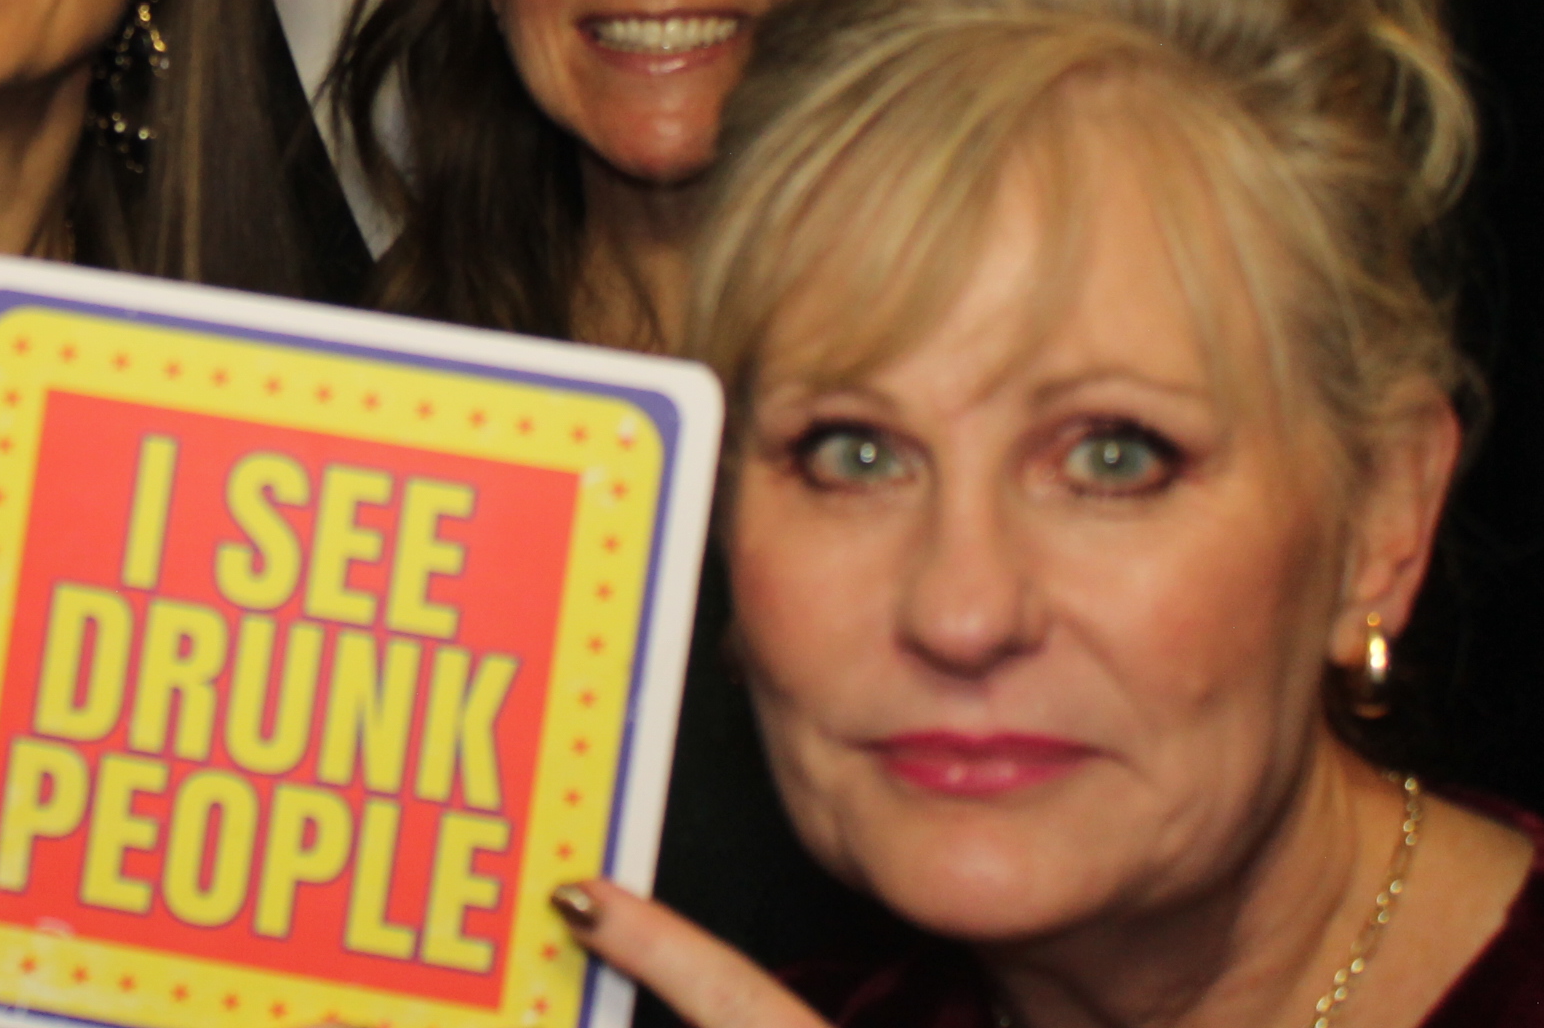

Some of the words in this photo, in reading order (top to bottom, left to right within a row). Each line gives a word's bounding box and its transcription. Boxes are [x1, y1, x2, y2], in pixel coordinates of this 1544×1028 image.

[122, 434, 177, 590] I
[215, 451, 475, 639] SEE
[33, 581, 519, 810] DRUNK
